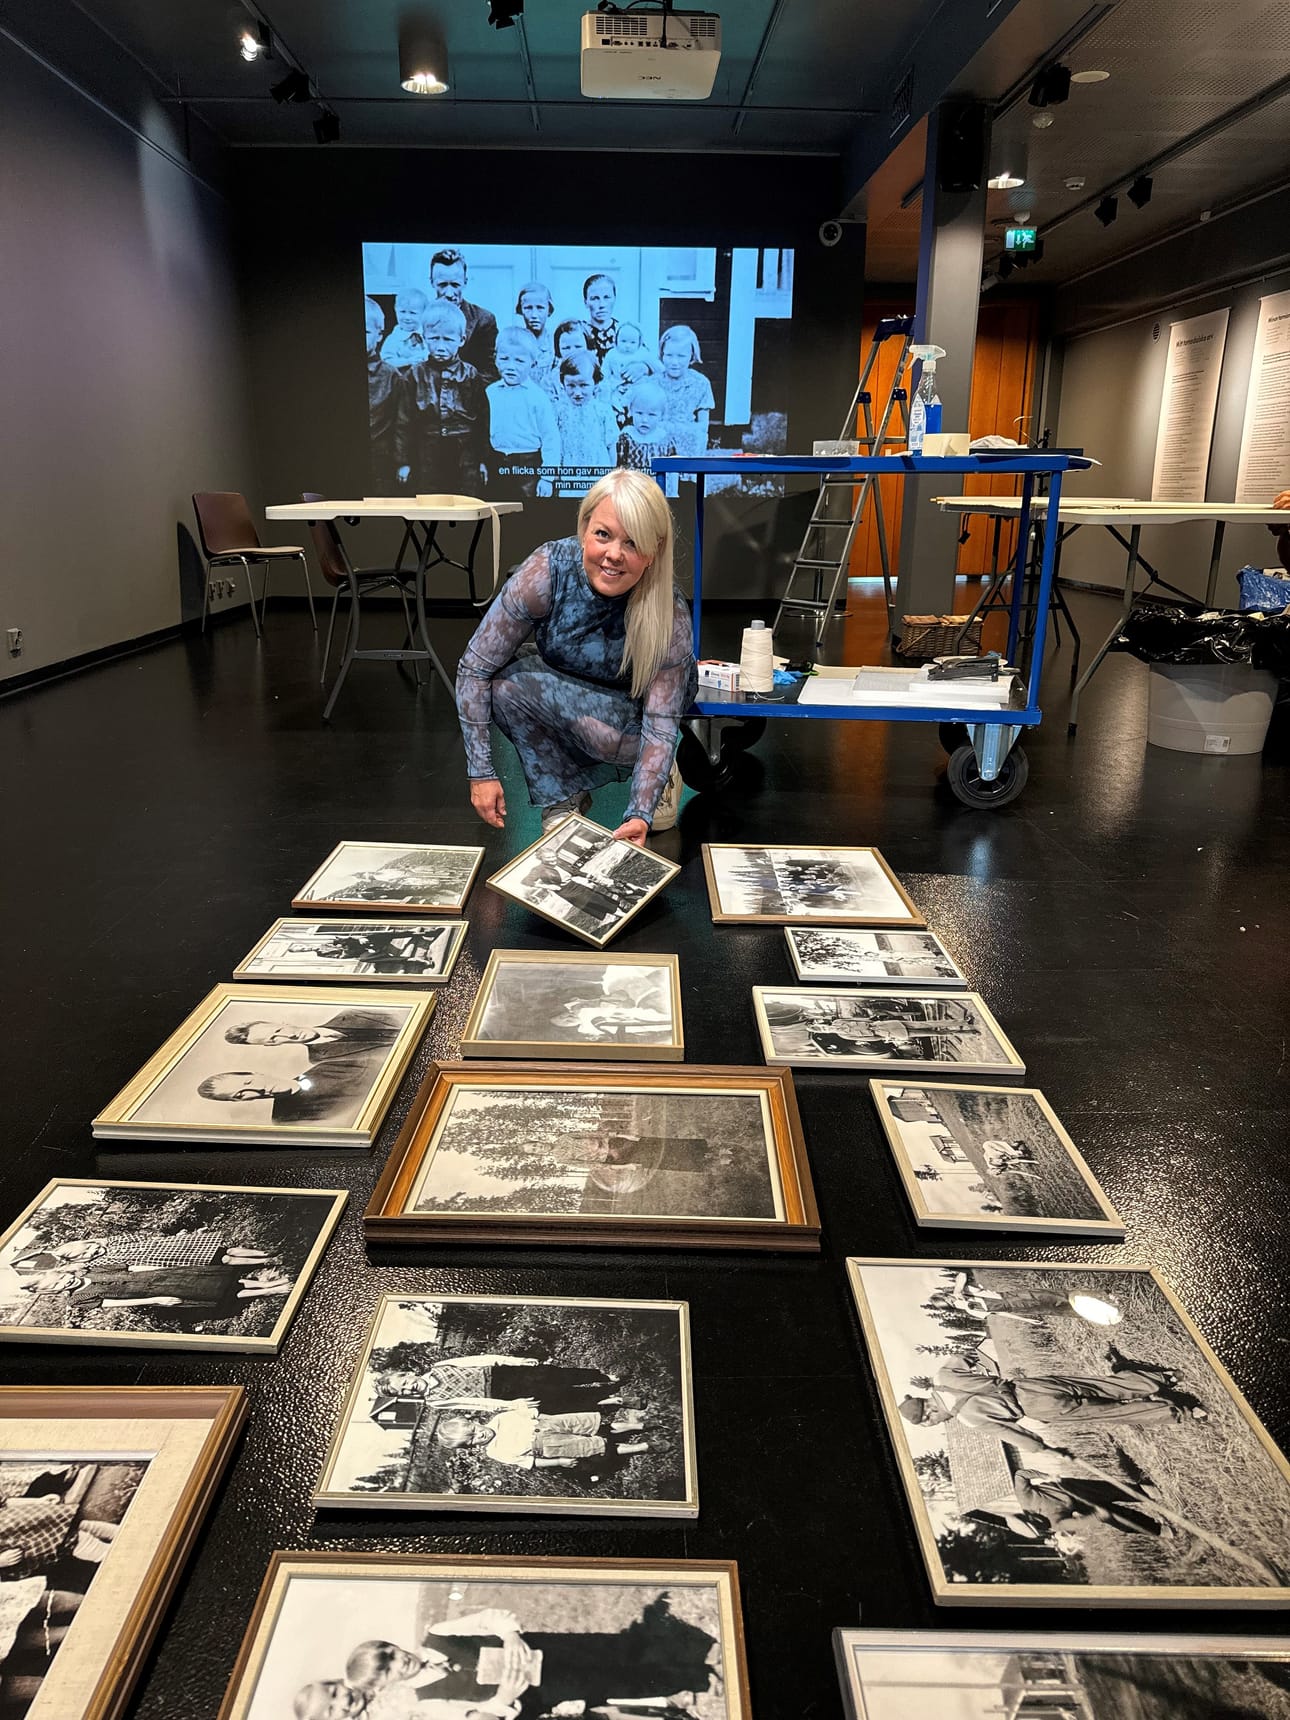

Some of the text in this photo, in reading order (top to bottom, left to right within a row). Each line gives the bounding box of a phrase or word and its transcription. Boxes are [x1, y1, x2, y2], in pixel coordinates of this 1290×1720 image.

[499, 467, 510, 475] en
[512, 466, 534, 475] flicka
[557, 466, 574, 475] hon
[576, 468, 592, 477] gav
[555, 481, 571, 489] min
